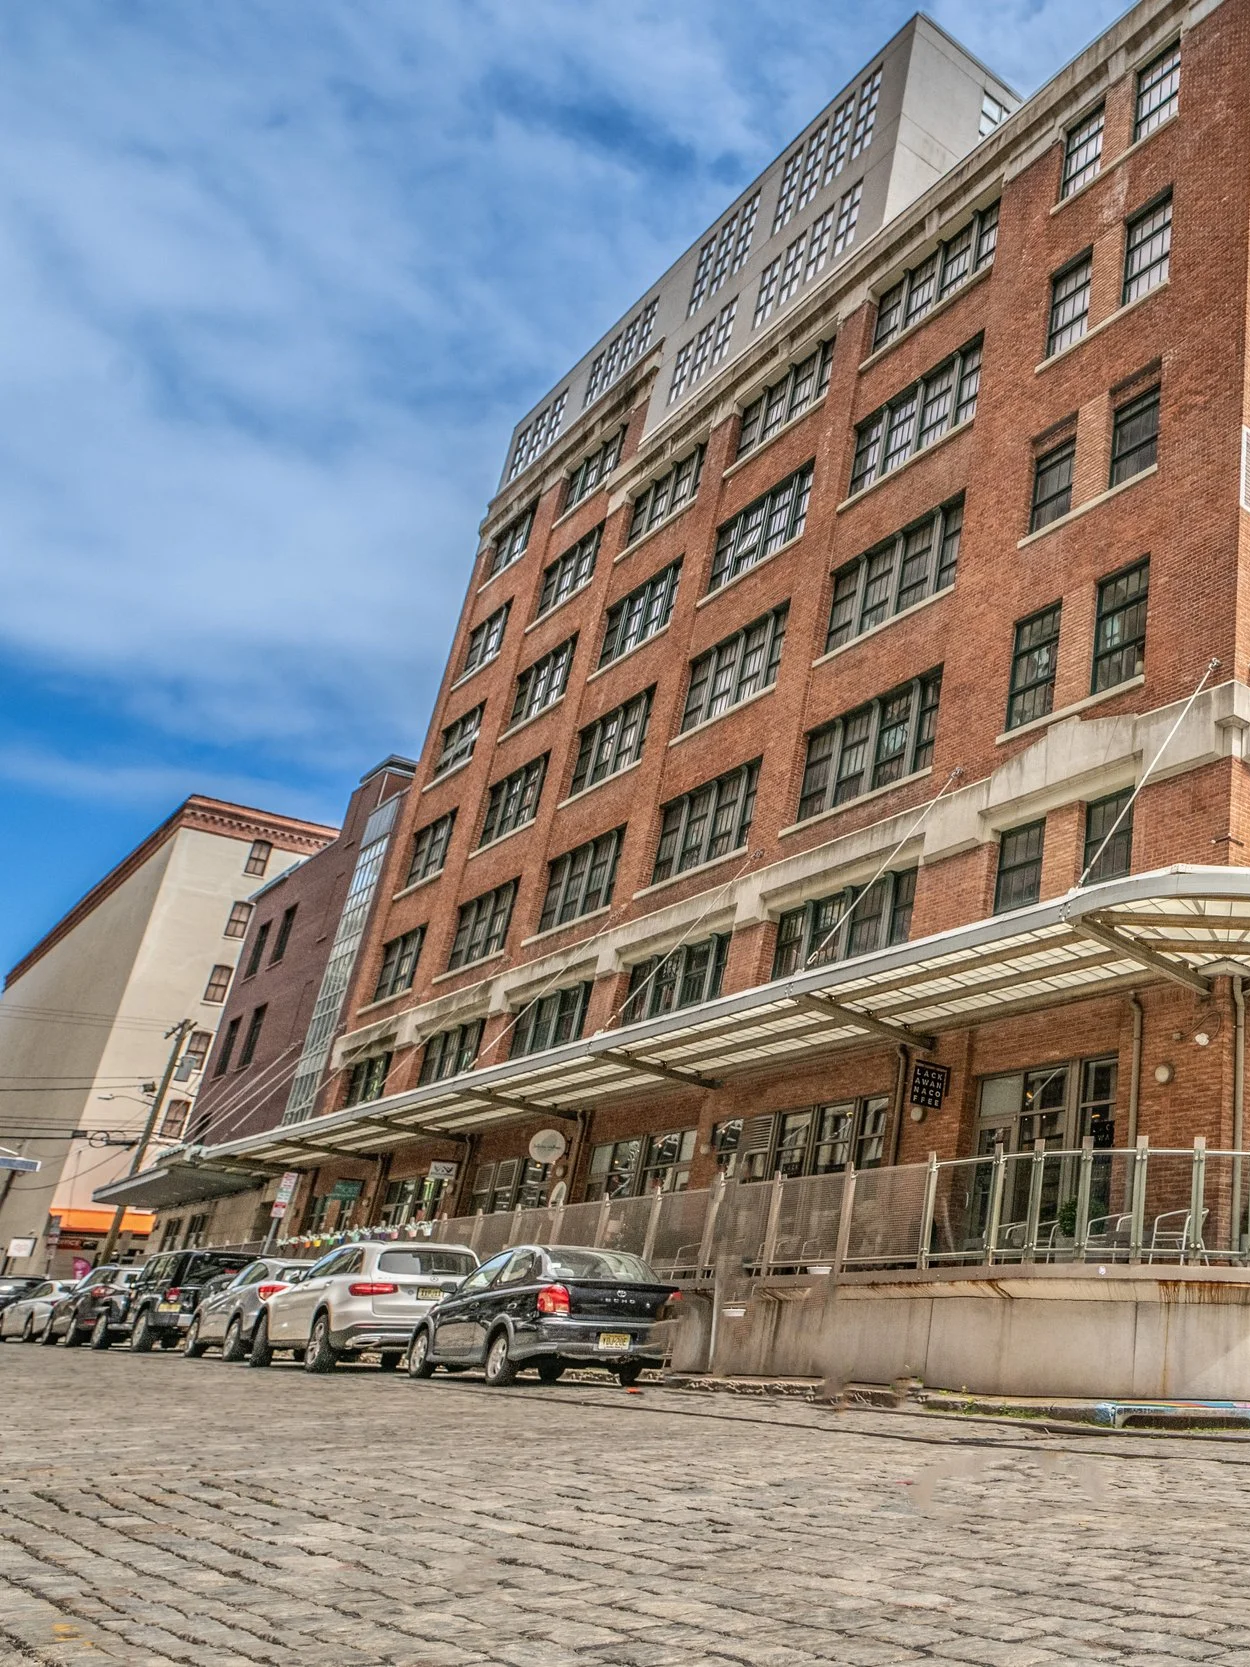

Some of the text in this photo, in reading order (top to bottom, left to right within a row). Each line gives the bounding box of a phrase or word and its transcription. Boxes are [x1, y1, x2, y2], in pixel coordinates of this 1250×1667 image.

[916, 1068, 943, 1081] LACK
[914, 1077, 942, 1090] AWAN
[913, 1085, 941, 1098] NACO
[912, 1094, 940, 1107] FFEE
